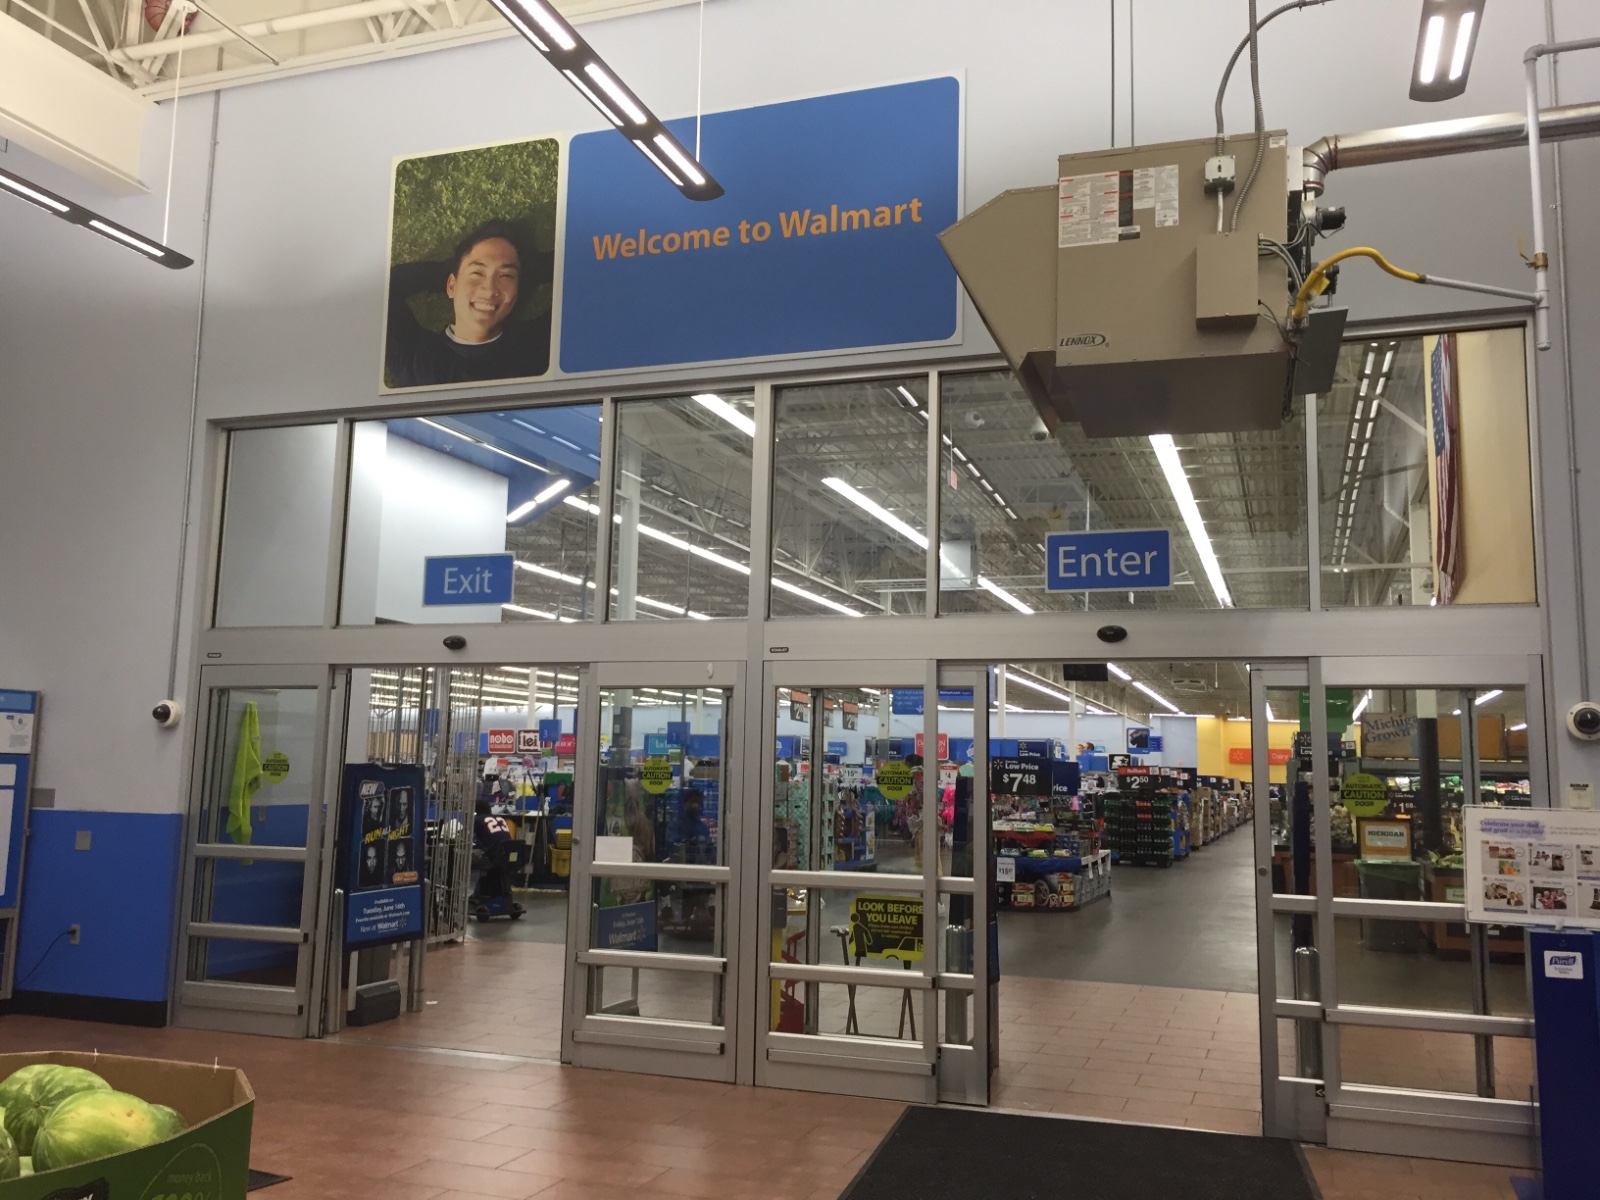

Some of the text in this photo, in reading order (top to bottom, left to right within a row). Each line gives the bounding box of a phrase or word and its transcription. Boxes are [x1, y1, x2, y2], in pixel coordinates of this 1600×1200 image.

[592, 198, 923, 260] Welcome to Walmart
[1060, 334, 1098, 347] LENNOX
[1058, 546, 1158, 578] Enter
[443, 566, 493, 594] Exit
[1364, 714, 1419, 730] Michiga
[490, 733, 514, 744] nobo
[543, 729, 548, 739] 3
[1365, 729, 1411, 743] Grown
[523, 735, 538, 747] lei
[1271, 752, 1289, 761] Dairy
[878, 776, 912, 785] CAUTION
[360, 782, 380, 796] NEW
[1053, 783, 1068, 792] rice
[1343, 790, 1385, 799] CAUTION
[364, 828, 383, 845] RUN
[388, 823, 410, 842] NIGHT
[363, 906, 382, 914] Tuesday,
[858, 901, 924, 914] LOOK BEFORE
[377, 920, 399, 930] Walmart
[866, 913, 918, 925] YOU LEAVE
[608, 930, 637, 945] Walmart
[166, 1171, 212, 1185] money back
